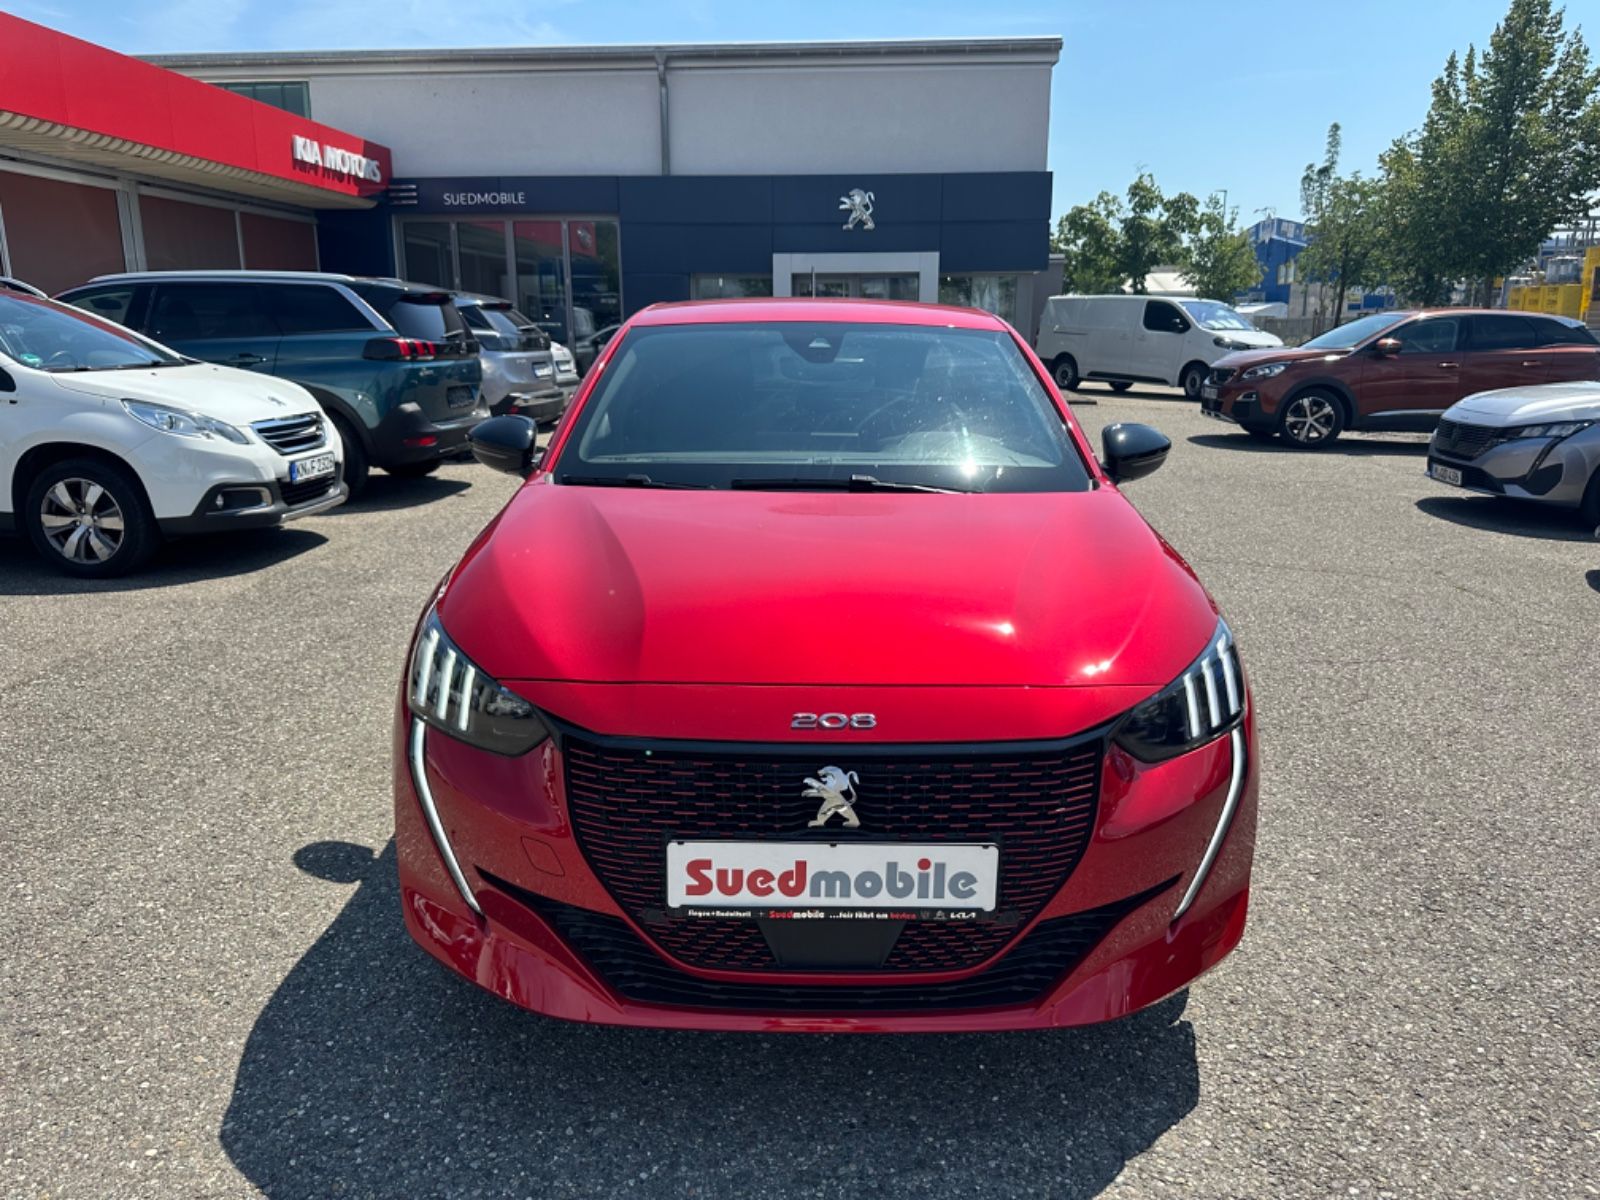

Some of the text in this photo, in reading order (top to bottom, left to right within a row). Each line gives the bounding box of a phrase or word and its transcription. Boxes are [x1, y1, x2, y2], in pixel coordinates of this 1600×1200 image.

[293, 135, 381, 183] KIA MOTORS
[443, 192, 526, 206] SUEDMOBILE
[791, 712, 877, 729] 208
[685, 858, 979, 900] Suedmobile
